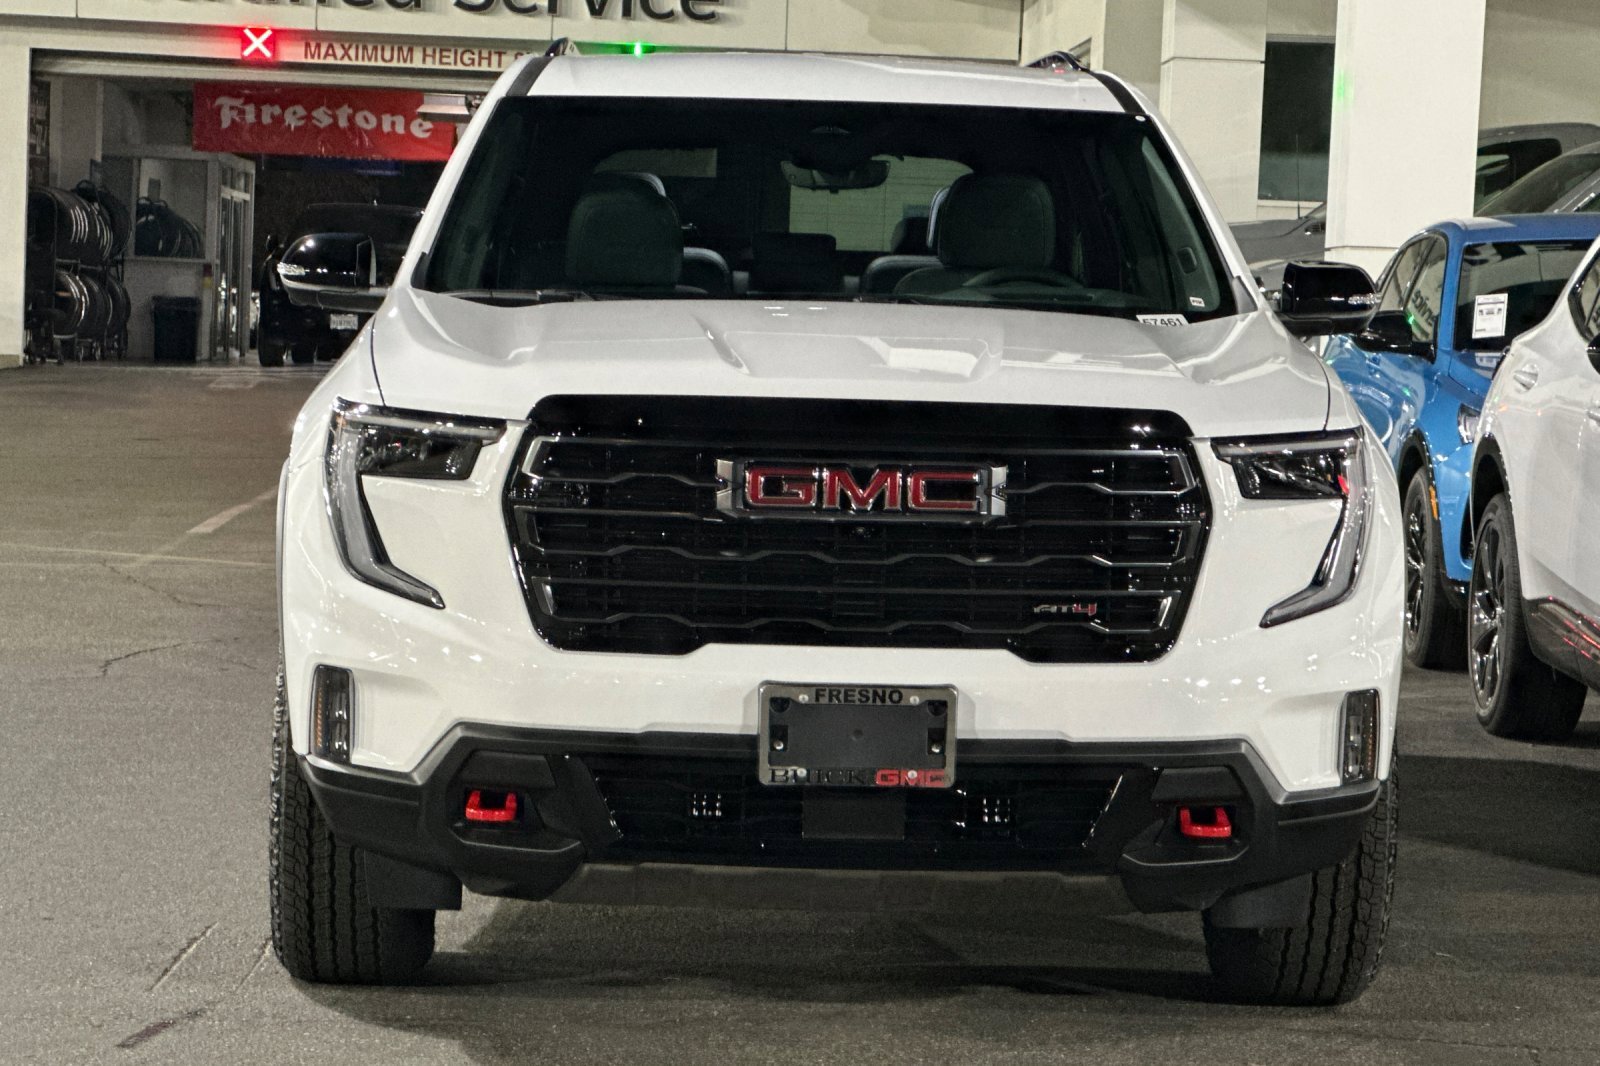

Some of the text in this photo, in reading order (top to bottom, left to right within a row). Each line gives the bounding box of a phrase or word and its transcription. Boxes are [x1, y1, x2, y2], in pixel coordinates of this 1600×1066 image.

[303, 41, 507, 69] MAXIMUM HEIGHT
[214, 96, 435, 139] Firestone
[745, 467, 981, 510] GMC
[814, 688, 904, 704] FRESNO
[875, 768, 946, 786] GMC
